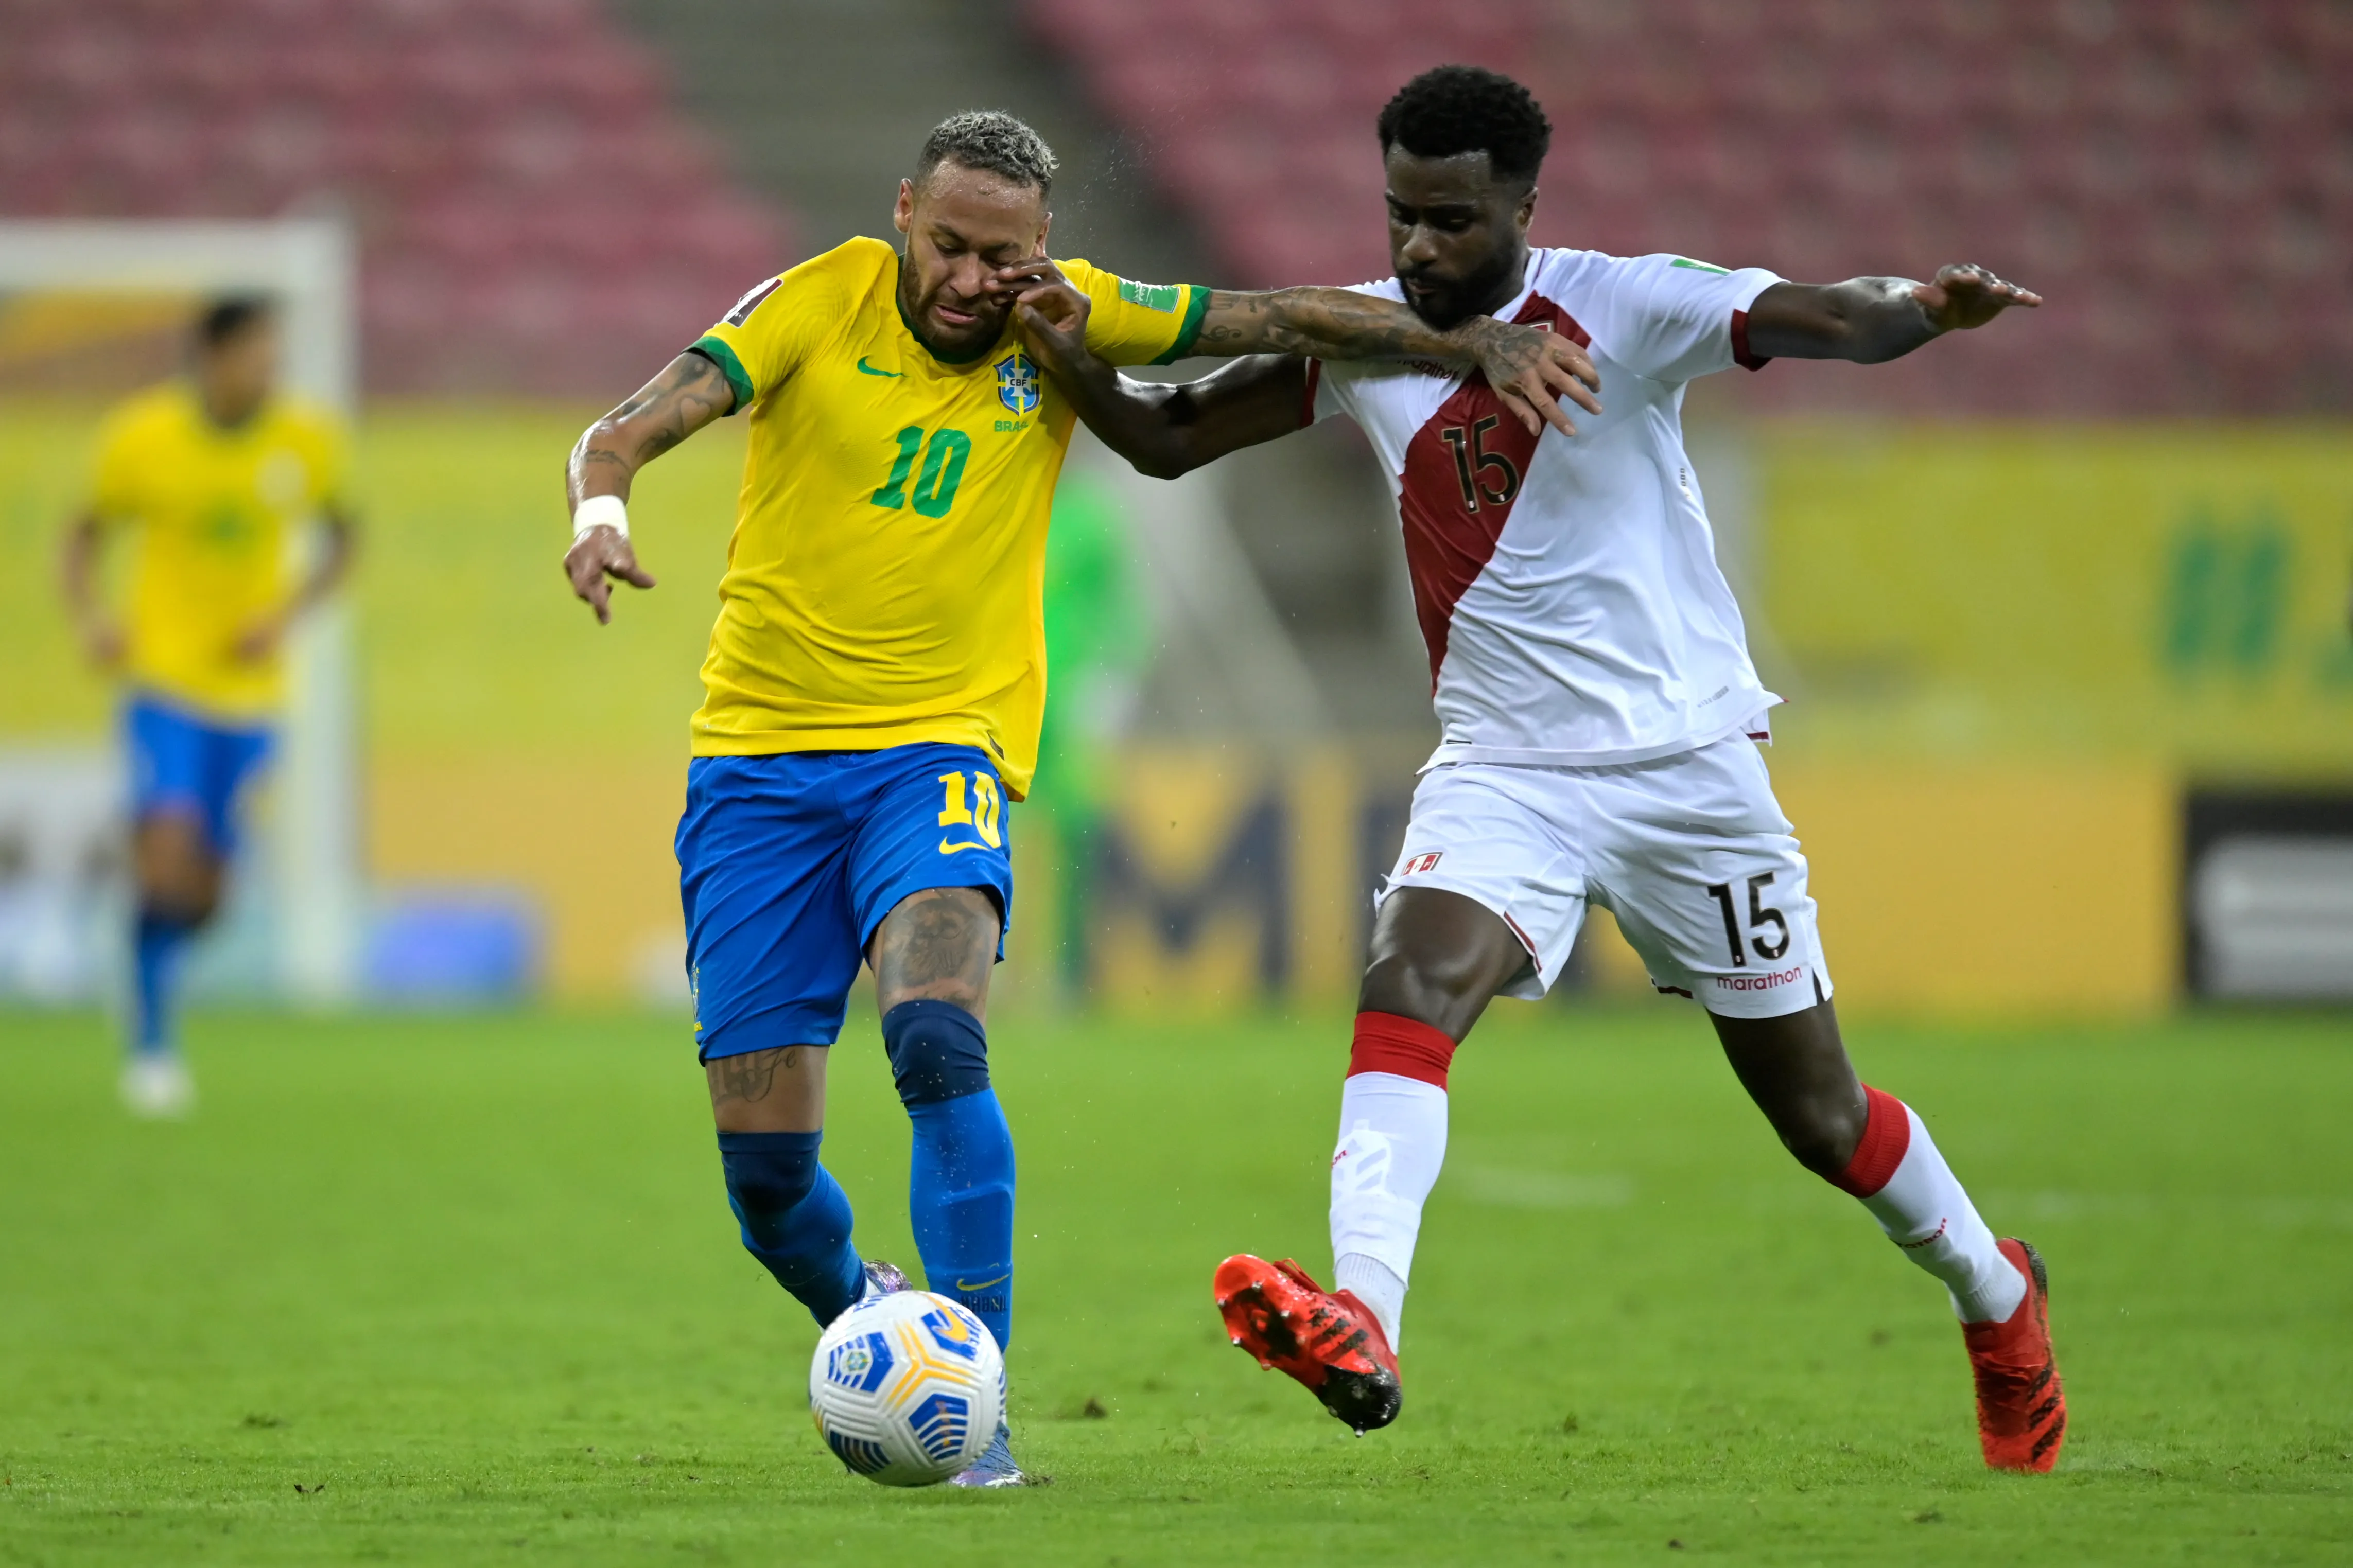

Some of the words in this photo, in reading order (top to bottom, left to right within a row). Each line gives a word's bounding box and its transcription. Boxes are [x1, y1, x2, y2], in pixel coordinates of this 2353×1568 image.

[870, 425, 972, 519] 10
[1441, 413, 1520, 514] 15
[938, 771, 1001, 848] 10
[1707, 871, 1790, 968] 15
[1717, 966, 1802, 991] marathon
